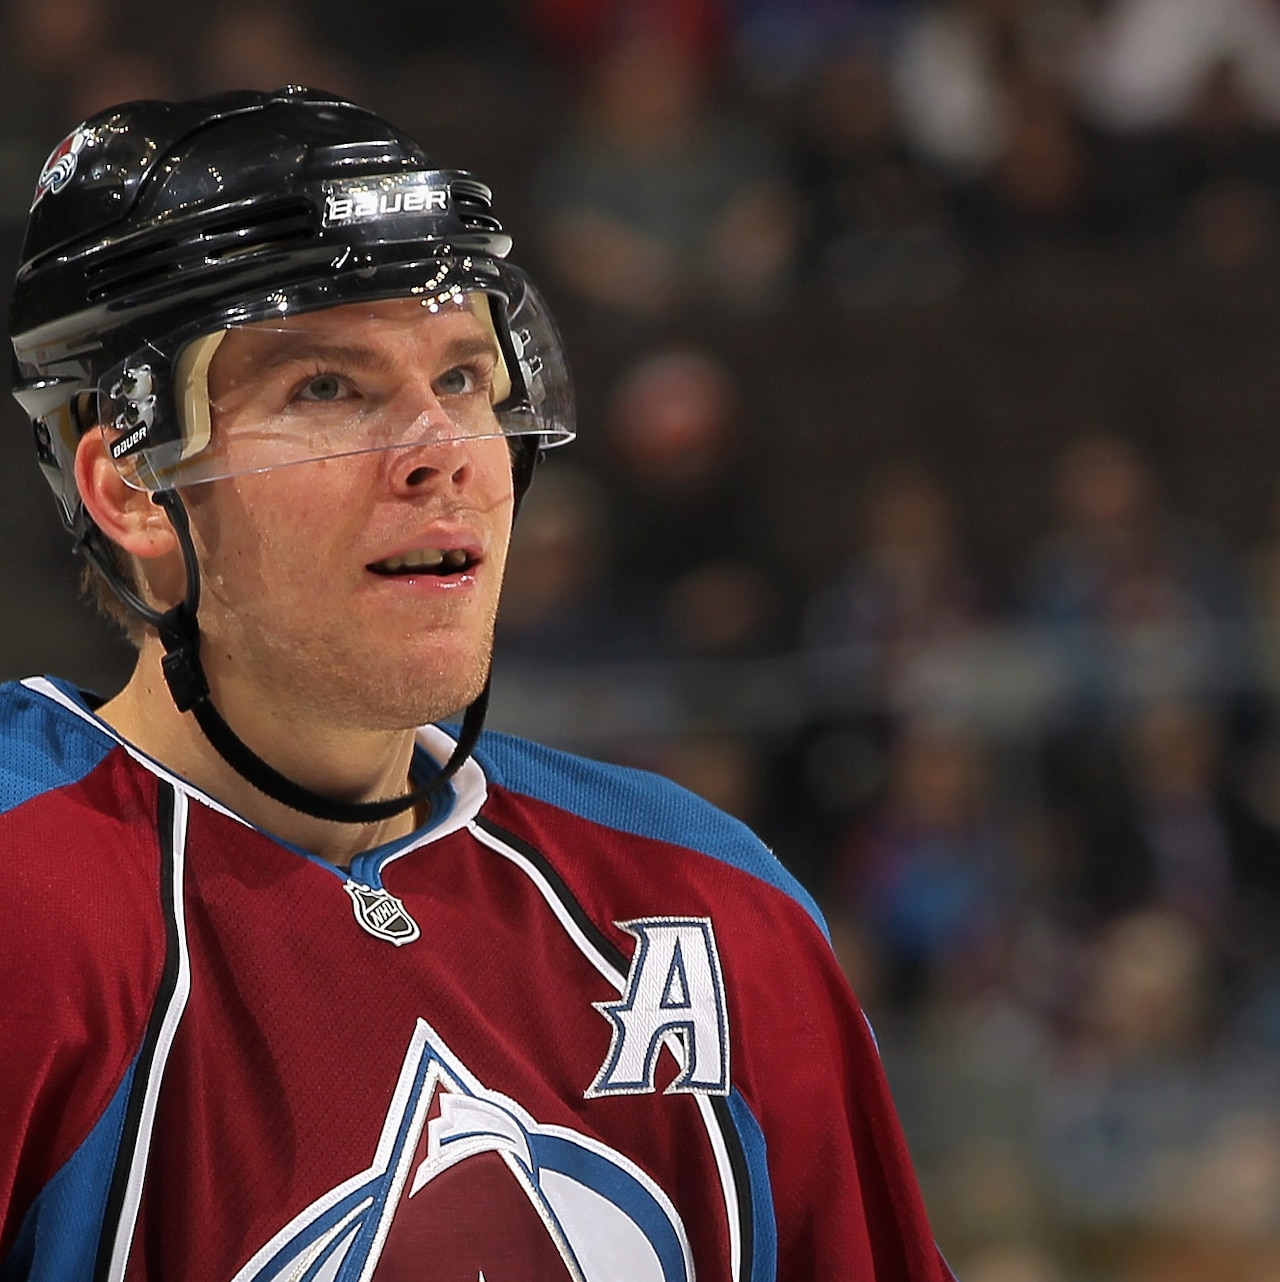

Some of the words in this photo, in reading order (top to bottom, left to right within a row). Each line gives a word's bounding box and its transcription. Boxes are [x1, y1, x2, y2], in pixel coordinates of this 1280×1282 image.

[328, 190, 448, 221] BAUER
[113, 426, 147, 458] BAUER
[369, 900, 399, 929] NHL
[583, 916, 731, 1099] A
